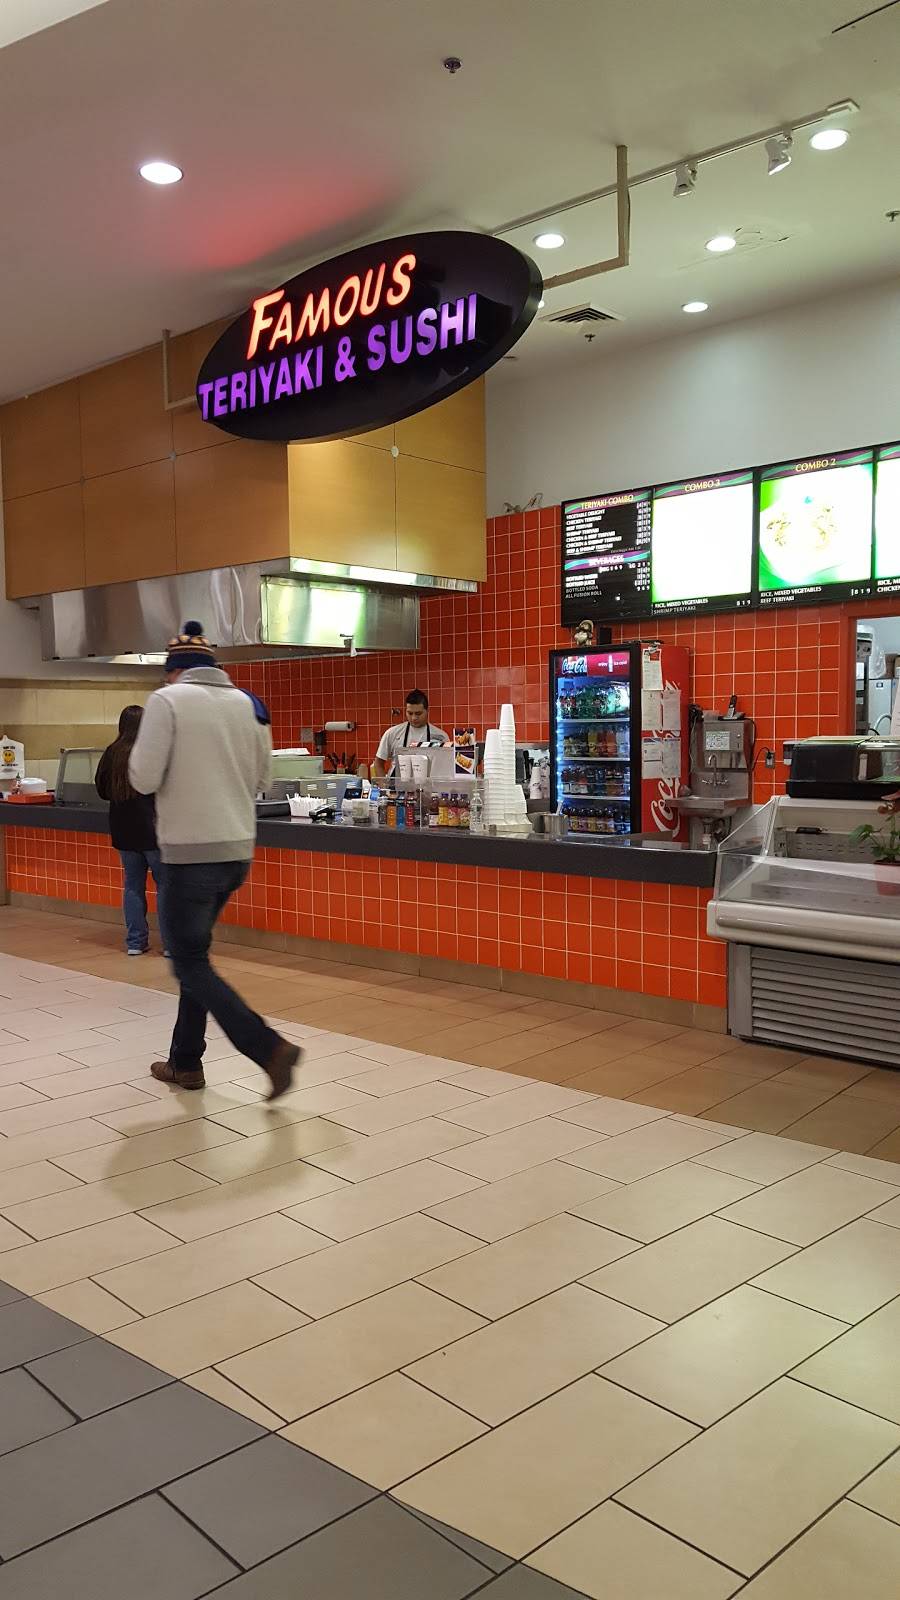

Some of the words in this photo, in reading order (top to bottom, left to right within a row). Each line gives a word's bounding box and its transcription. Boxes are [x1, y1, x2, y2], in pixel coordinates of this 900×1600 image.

[247, 253, 417, 360] FAMOUS
[198, 345, 323, 420] TERIYAKI
[334, 336, 356, 382] &
[367, 292, 477, 371] SUSHI
[795, 460, 828, 472] COMBO
[829, 458, 836, 466] 2
[684, 481, 713, 492] COMBO
[713, 479, 721, 487] 3
[581, 500, 607, 510] TERIYAKI
[608, 494, 634, 506] COMBO
[566, 518, 584, 526] CHICKEN
[588, 555, 624, 566] BEVERAGES
[791, 586, 822, 595] VEGETABLES
[681, 598, 709, 606] VEGETABLES
[772, 595, 795, 603] TERIYAKI
